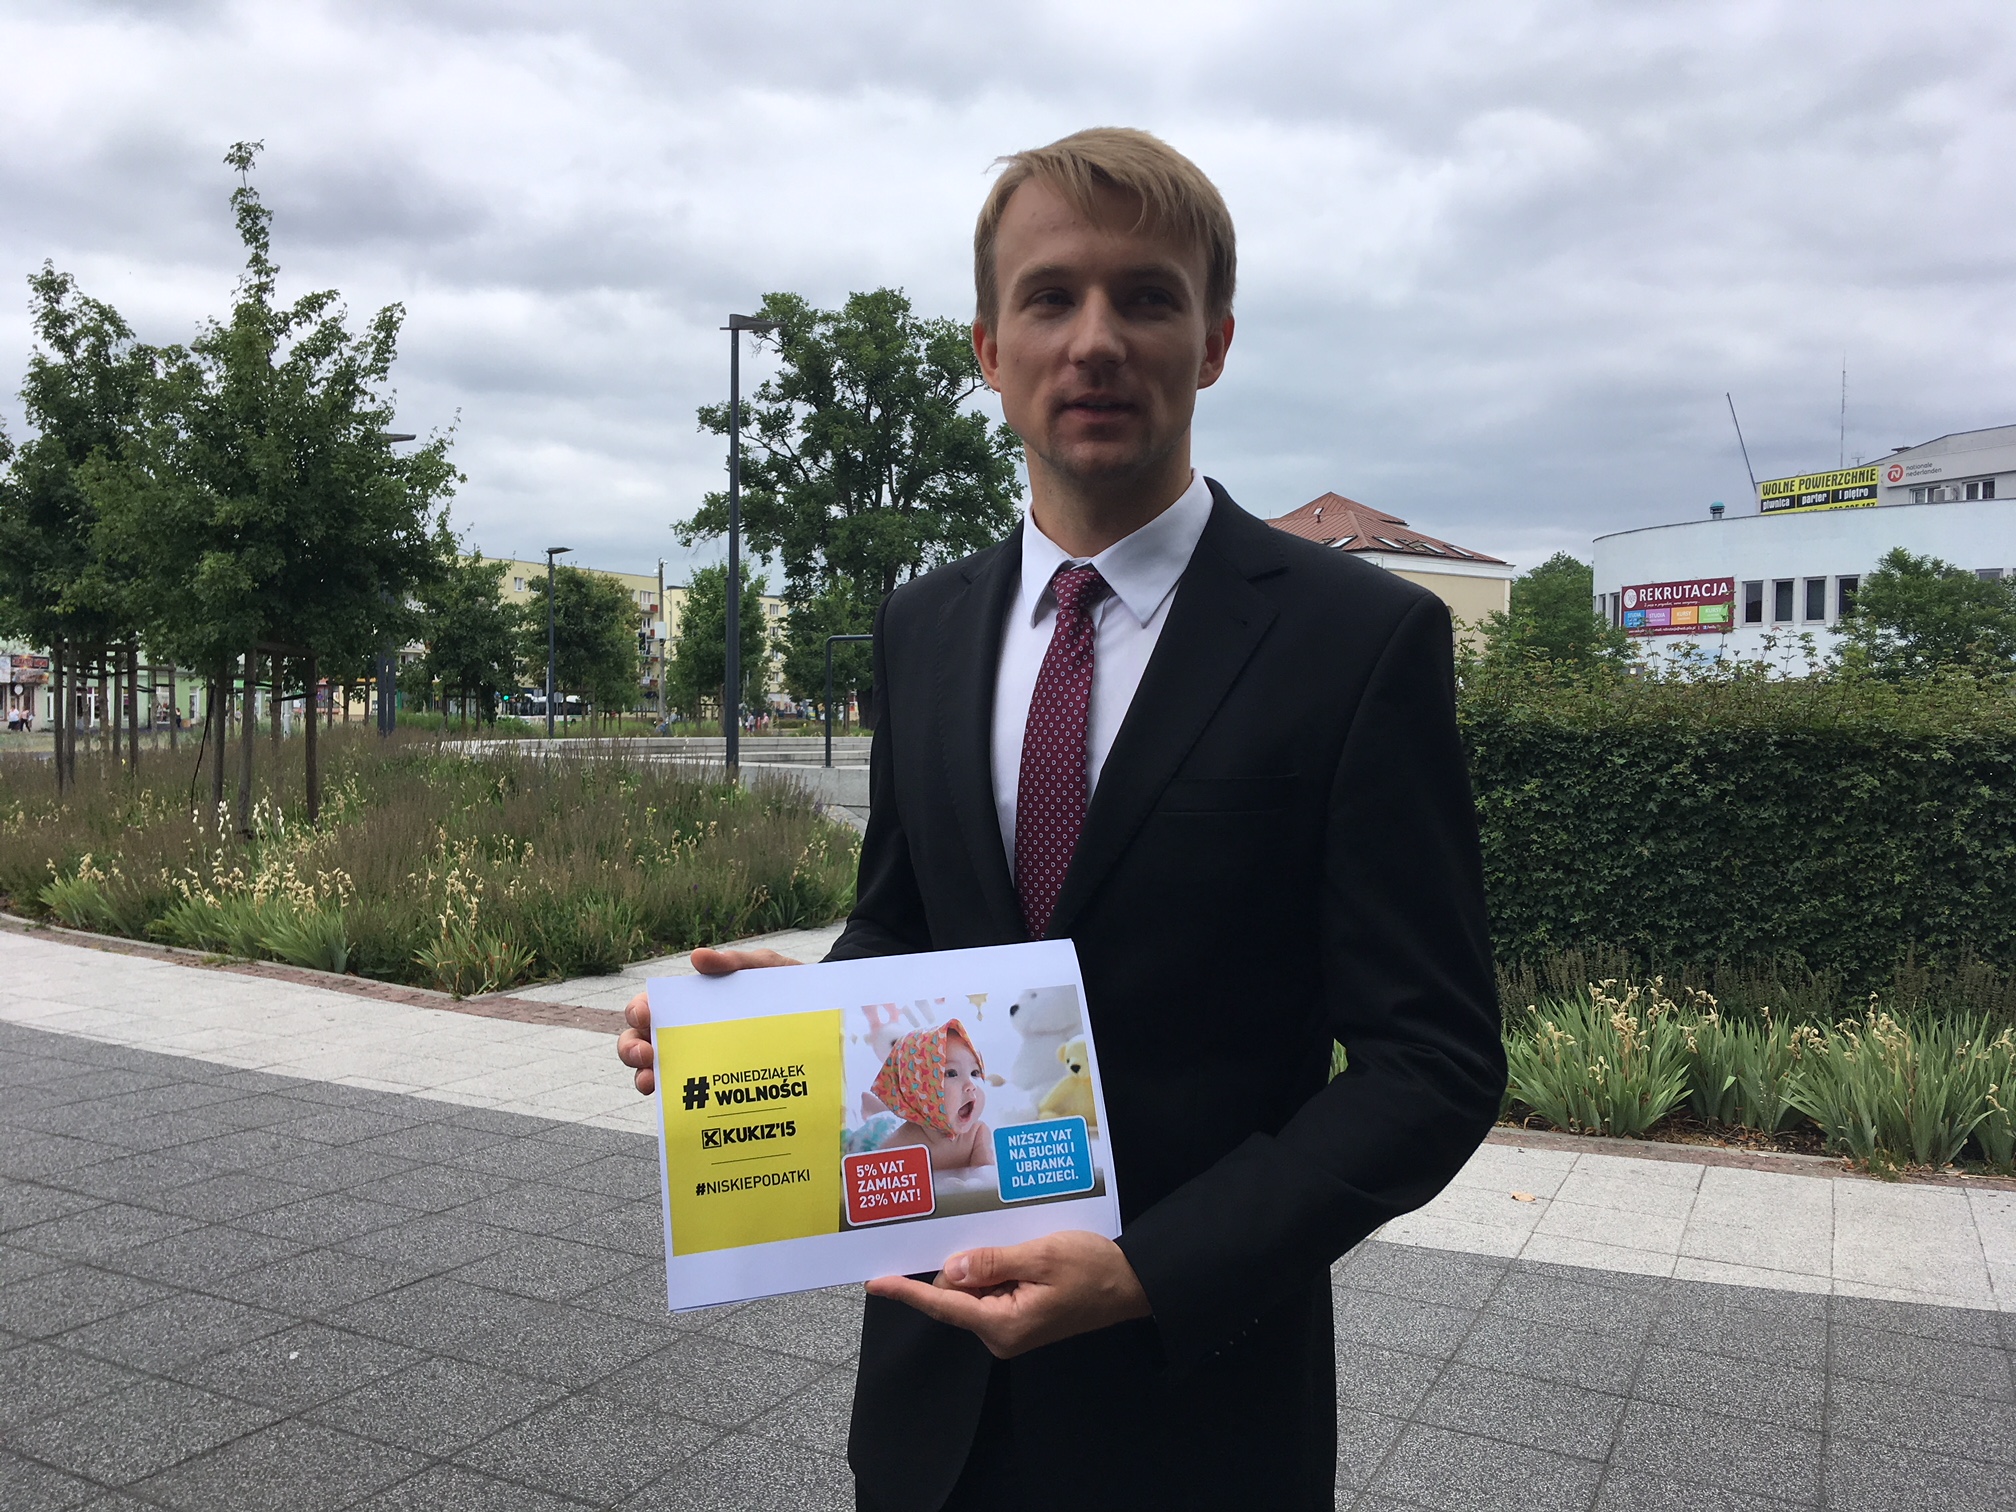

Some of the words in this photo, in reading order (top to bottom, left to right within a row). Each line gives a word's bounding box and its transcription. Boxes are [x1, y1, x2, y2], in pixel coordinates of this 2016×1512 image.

[1906, 462, 1933, 471] nationale
[1906, 467, 1942, 477] nederlanden
[1762, 480, 1795, 496] WOLNE
[1799, 468, 1876, 491] POWIERZCHNIE
[1802, 492, 1827, 505] parter
[1844, 487, 1869, 500] piętro
[1763, 498, 1790, 511] piwnica
[1639, 582, 1729, 602] REKRUTACJA
[712, 1064, 806, 1086] PONIEDZIAŁEK
[714, 1078, 809, 1107] WOLNOŚCI
[1007, 1130, 1049, 1147] NIŻSZY
[1050, 1128, 1073, 1142] VAT
[1009, 1147, 1028, 1161] NA
[1028, 1142, 1069, 1159] BUCIKI
[1071, 1141, 1075, 1153] I
[856, 1163, 878, 1178] 5%
[879, 1159, 905, 1175] VAT
[1015, 1155, 1075, 1174] UBRANKA
[695, 1168, 811, 1197] #NISKIEPODATKI
[857, 1173, 918, 1193] ZAMIAST
[1011, 1174, 1037, 1188] DLA
[1037, 1168, 1080, 1185] DZIECI.
[859, 1193, 889, 1209] 23%
[890, 1188, 921, 1204] VAT!
